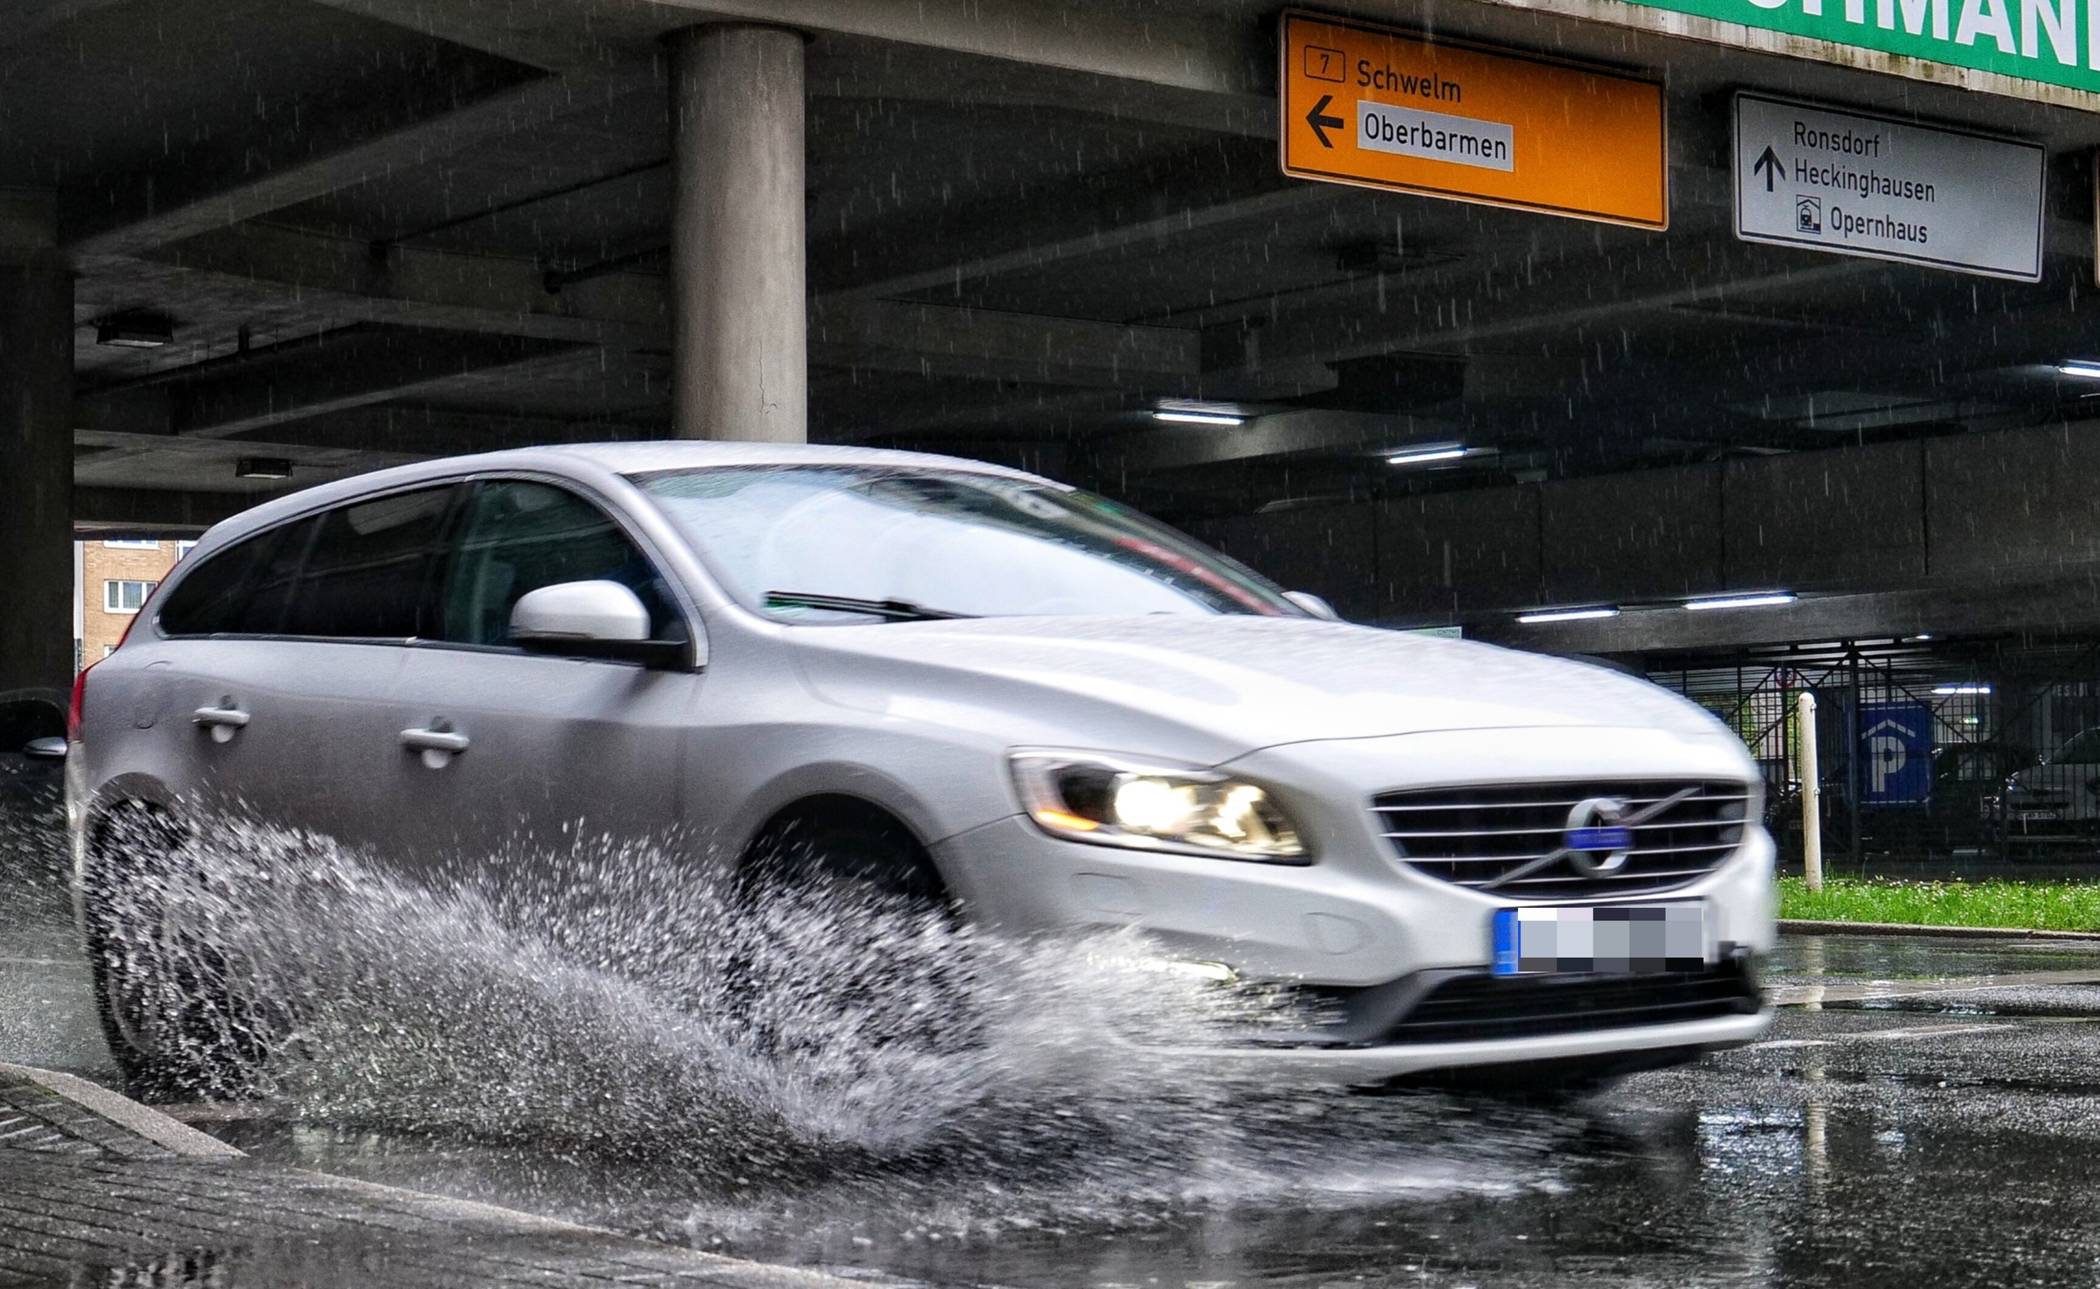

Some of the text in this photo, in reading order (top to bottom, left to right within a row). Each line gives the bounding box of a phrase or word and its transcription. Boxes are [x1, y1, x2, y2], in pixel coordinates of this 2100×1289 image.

[1320, 54, 1462, 103] 7 Schwelm
[1364, 112, 1507, 161] Oberbarmen
[1794, 120, 1880, 158] Ronsdorf
[1795, 157, 1935, 203] Heckinghausen
[1830, 206, 1928, 244] Opernhaus
[1871, 736, 1906, 792] P
